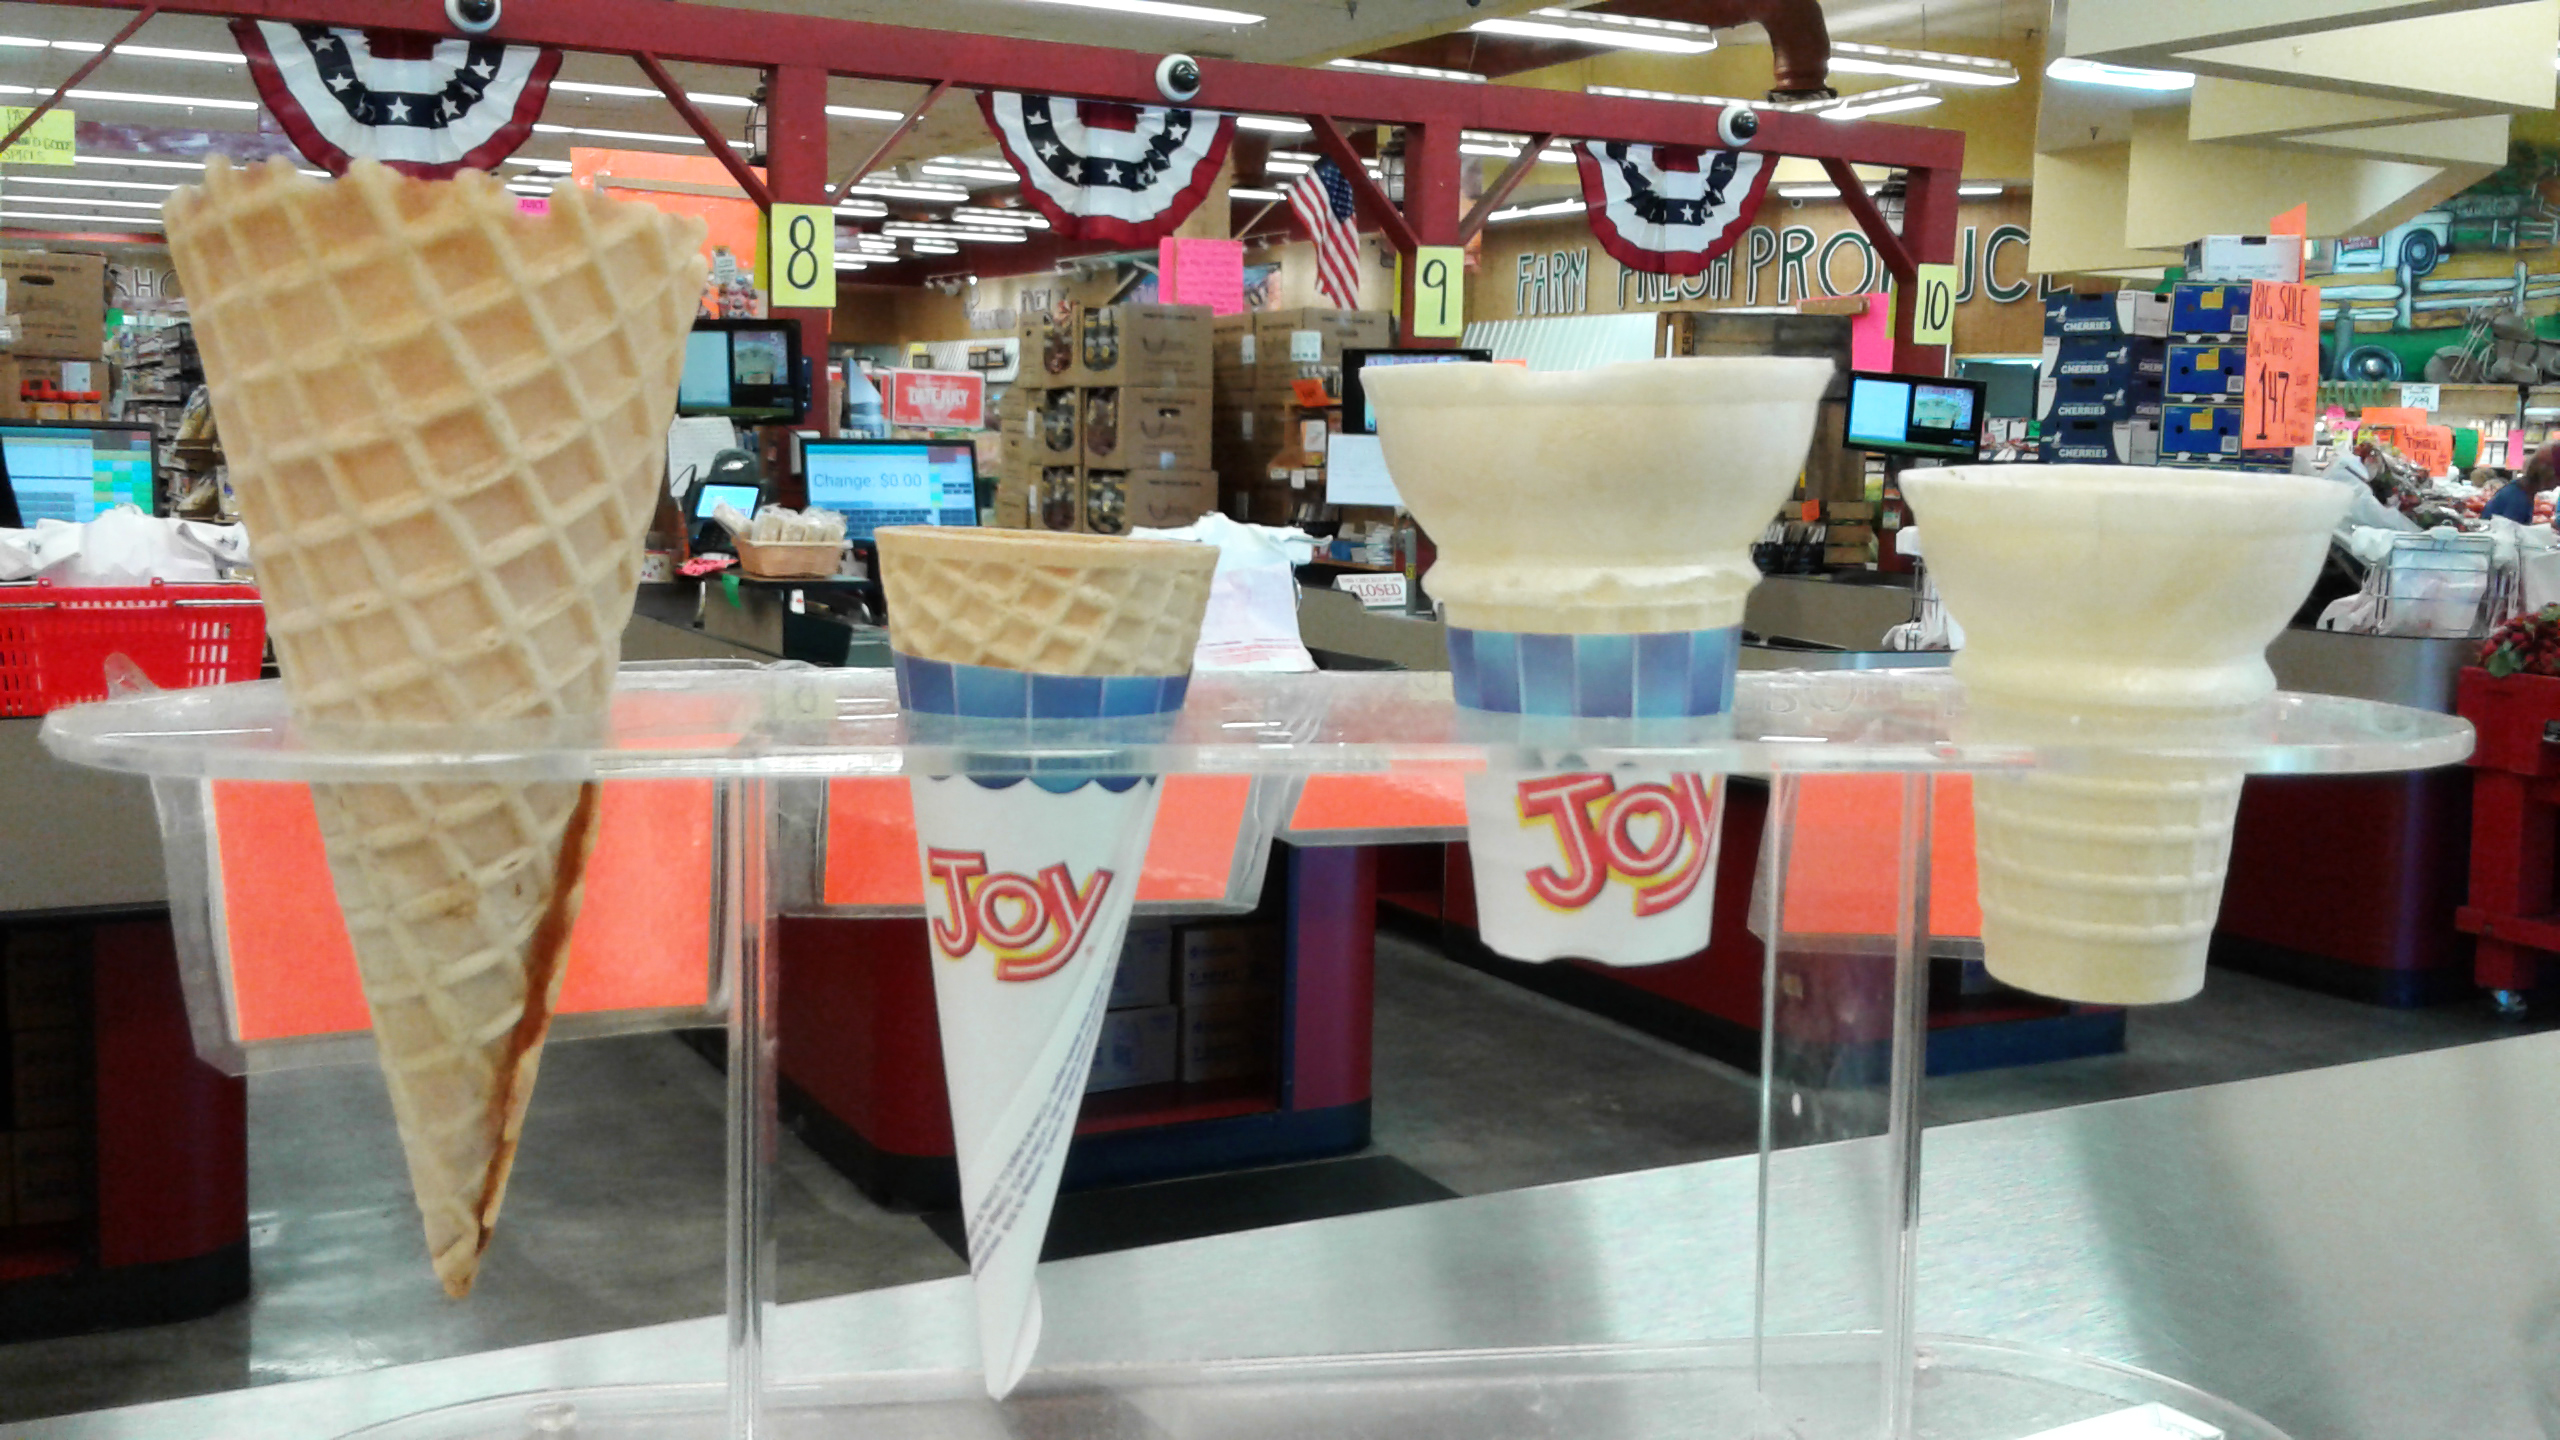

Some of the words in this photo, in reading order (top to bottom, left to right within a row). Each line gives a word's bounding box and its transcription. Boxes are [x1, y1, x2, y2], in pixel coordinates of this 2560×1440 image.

[787, 215, 818, 290] 8
[1517, 247, 1587, 315] FARM
[1745, 224, 2073, 305] PROC
[1422, 259, 1447, 325] 9
[1922, 279, 1950, 330] 10
[2279, 285, 2307, 326] SALE
[2063, 321, 2112, 332] CHERRIES
[2060, 363, 2109, 374] CHERRIES
[2058, 406, 2106, 416] CHERRIES
[2058, 448, 2108, 459] CHERRIES
[814, 473, 875, 490] Change:
[880, 473, 923, 488] $0.00
[1350, 583, 1402, 597] CLOSED
